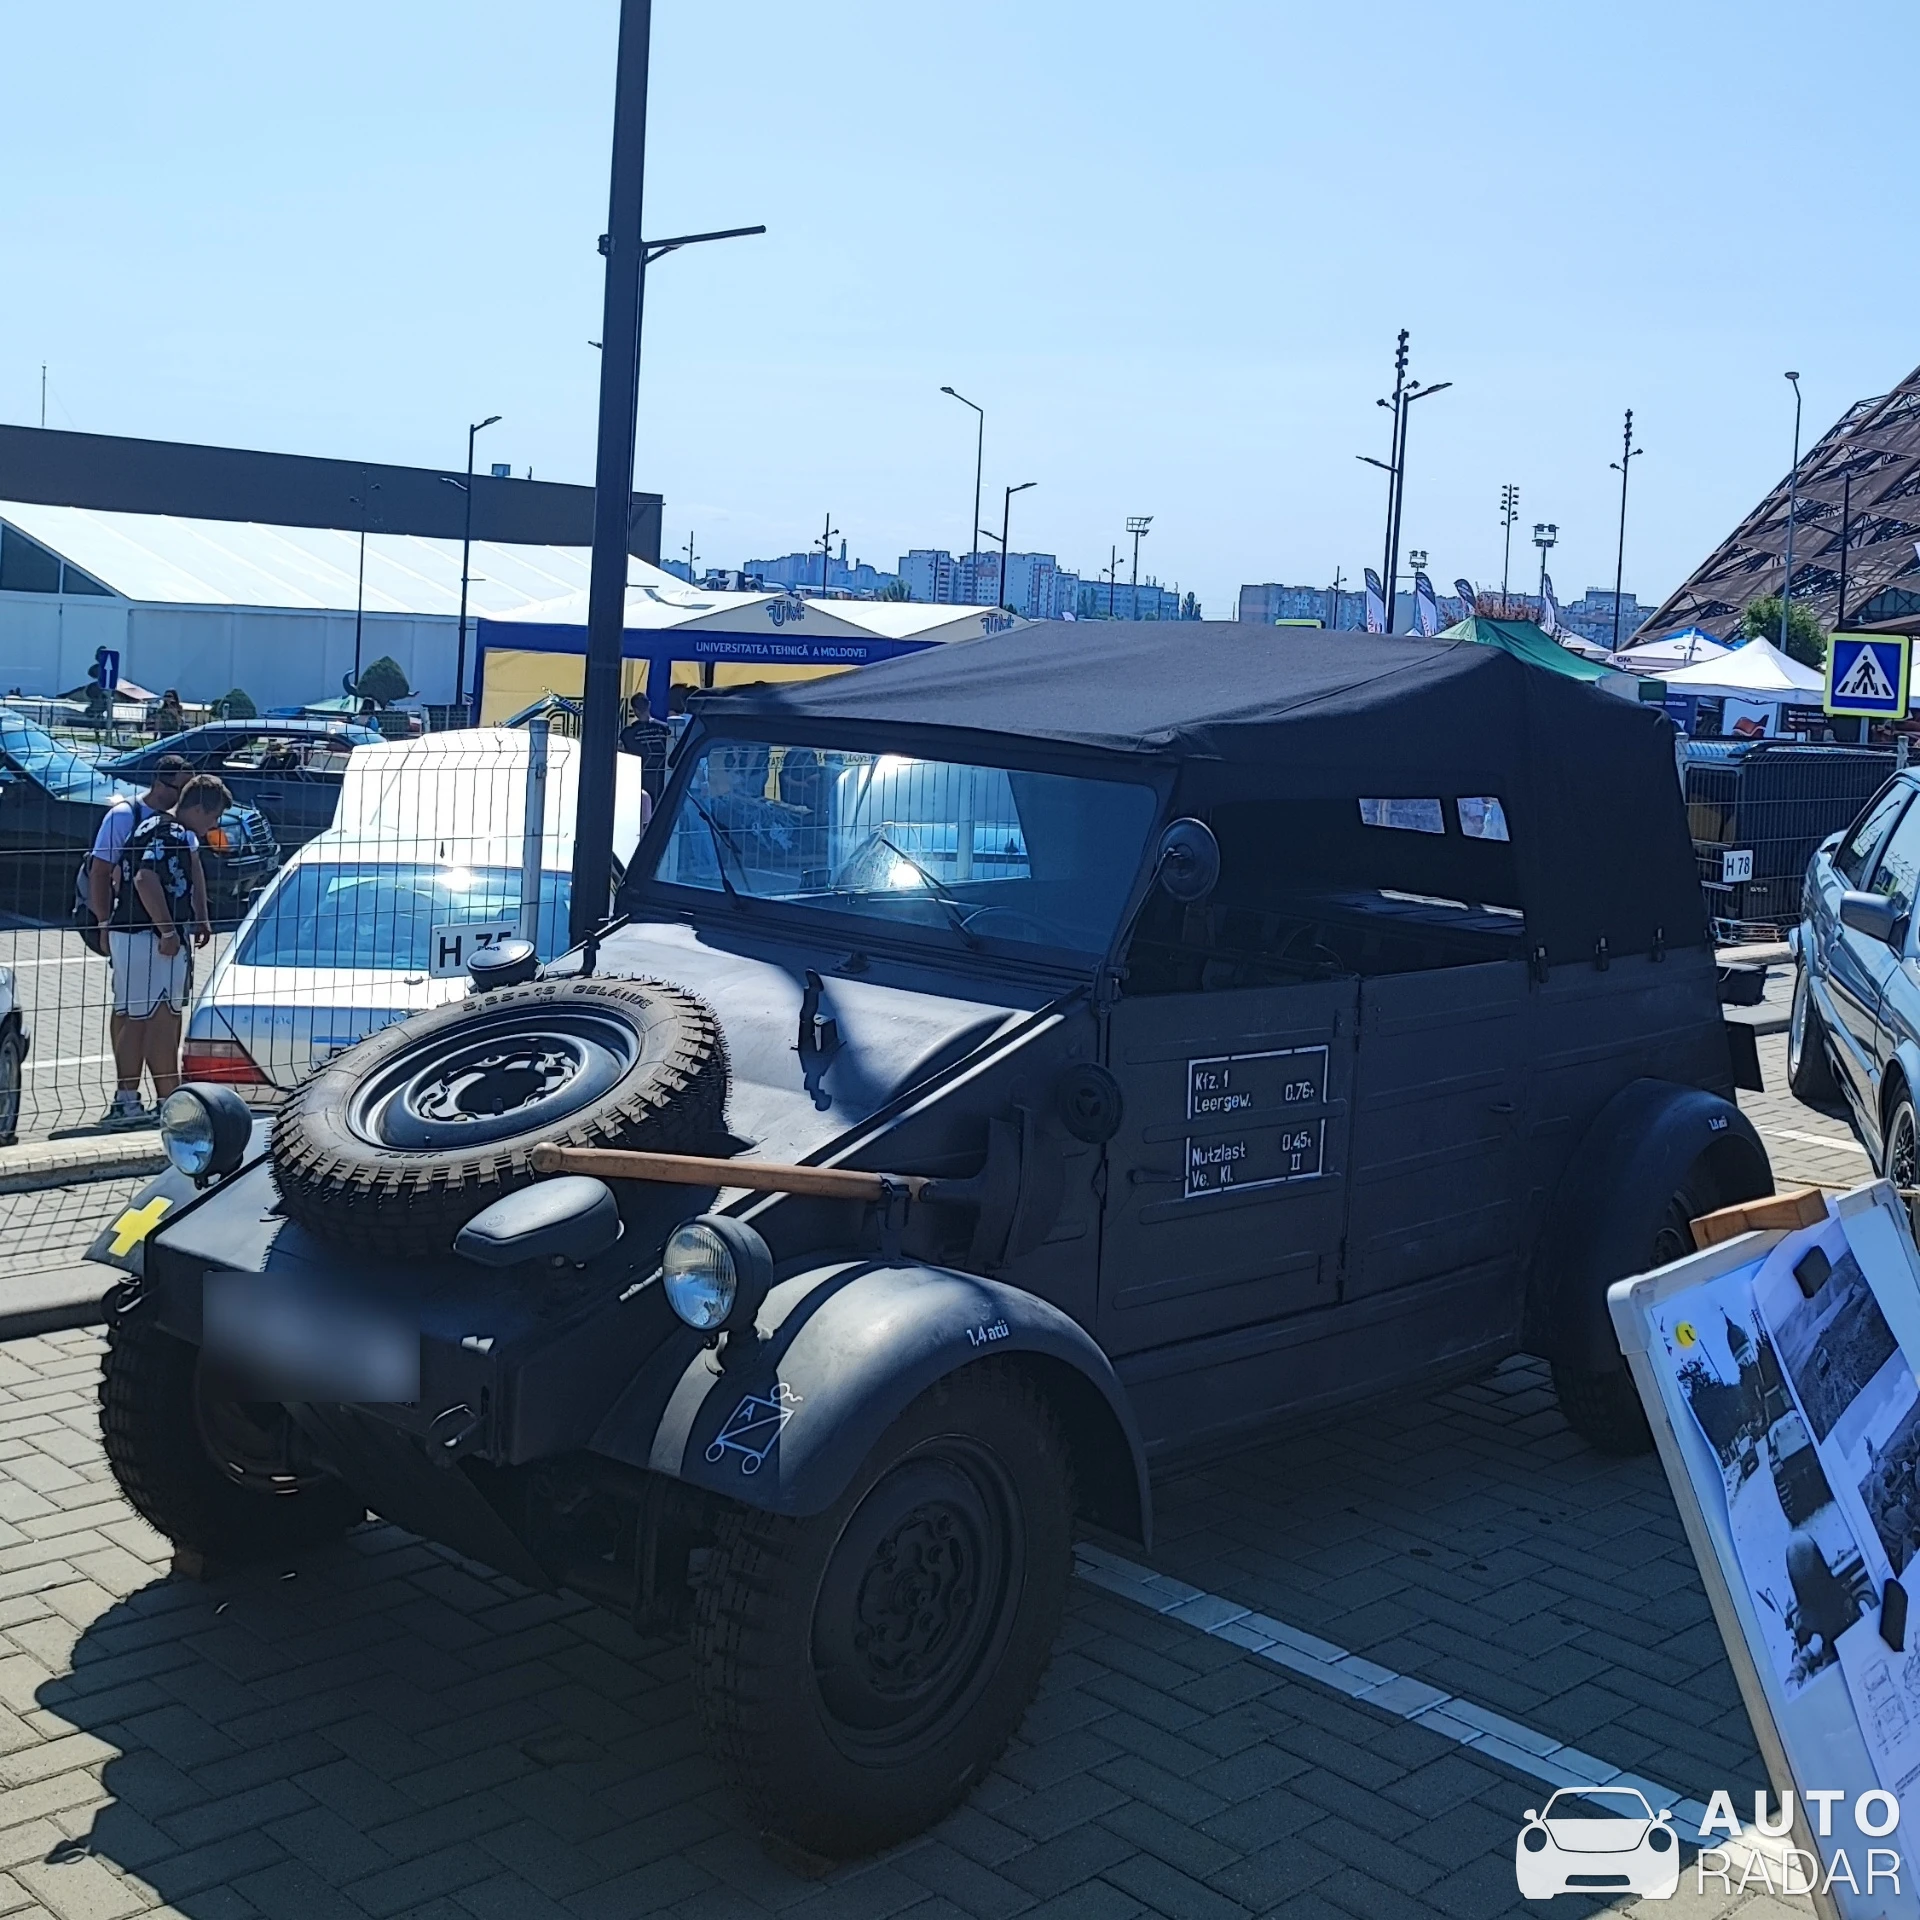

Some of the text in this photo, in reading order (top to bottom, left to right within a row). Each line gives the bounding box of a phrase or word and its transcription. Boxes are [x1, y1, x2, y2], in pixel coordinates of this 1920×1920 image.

[696, 641, 769, 655] UNIVERSITATEA
[813, 647, 820, 656] A
[821, 647, 867, 658] MOLDOVEI
[1726, 856, 1750, 876] H 78
[440, 935, 462, 968] H
[1195, 1069, 1229, 1091] Kfz. 1
[1191, 1140, 1246, 1167] Nutzlast
[1290, 1153, 1301, 1171] II
[987, 1319, 1010, 1341] atü
